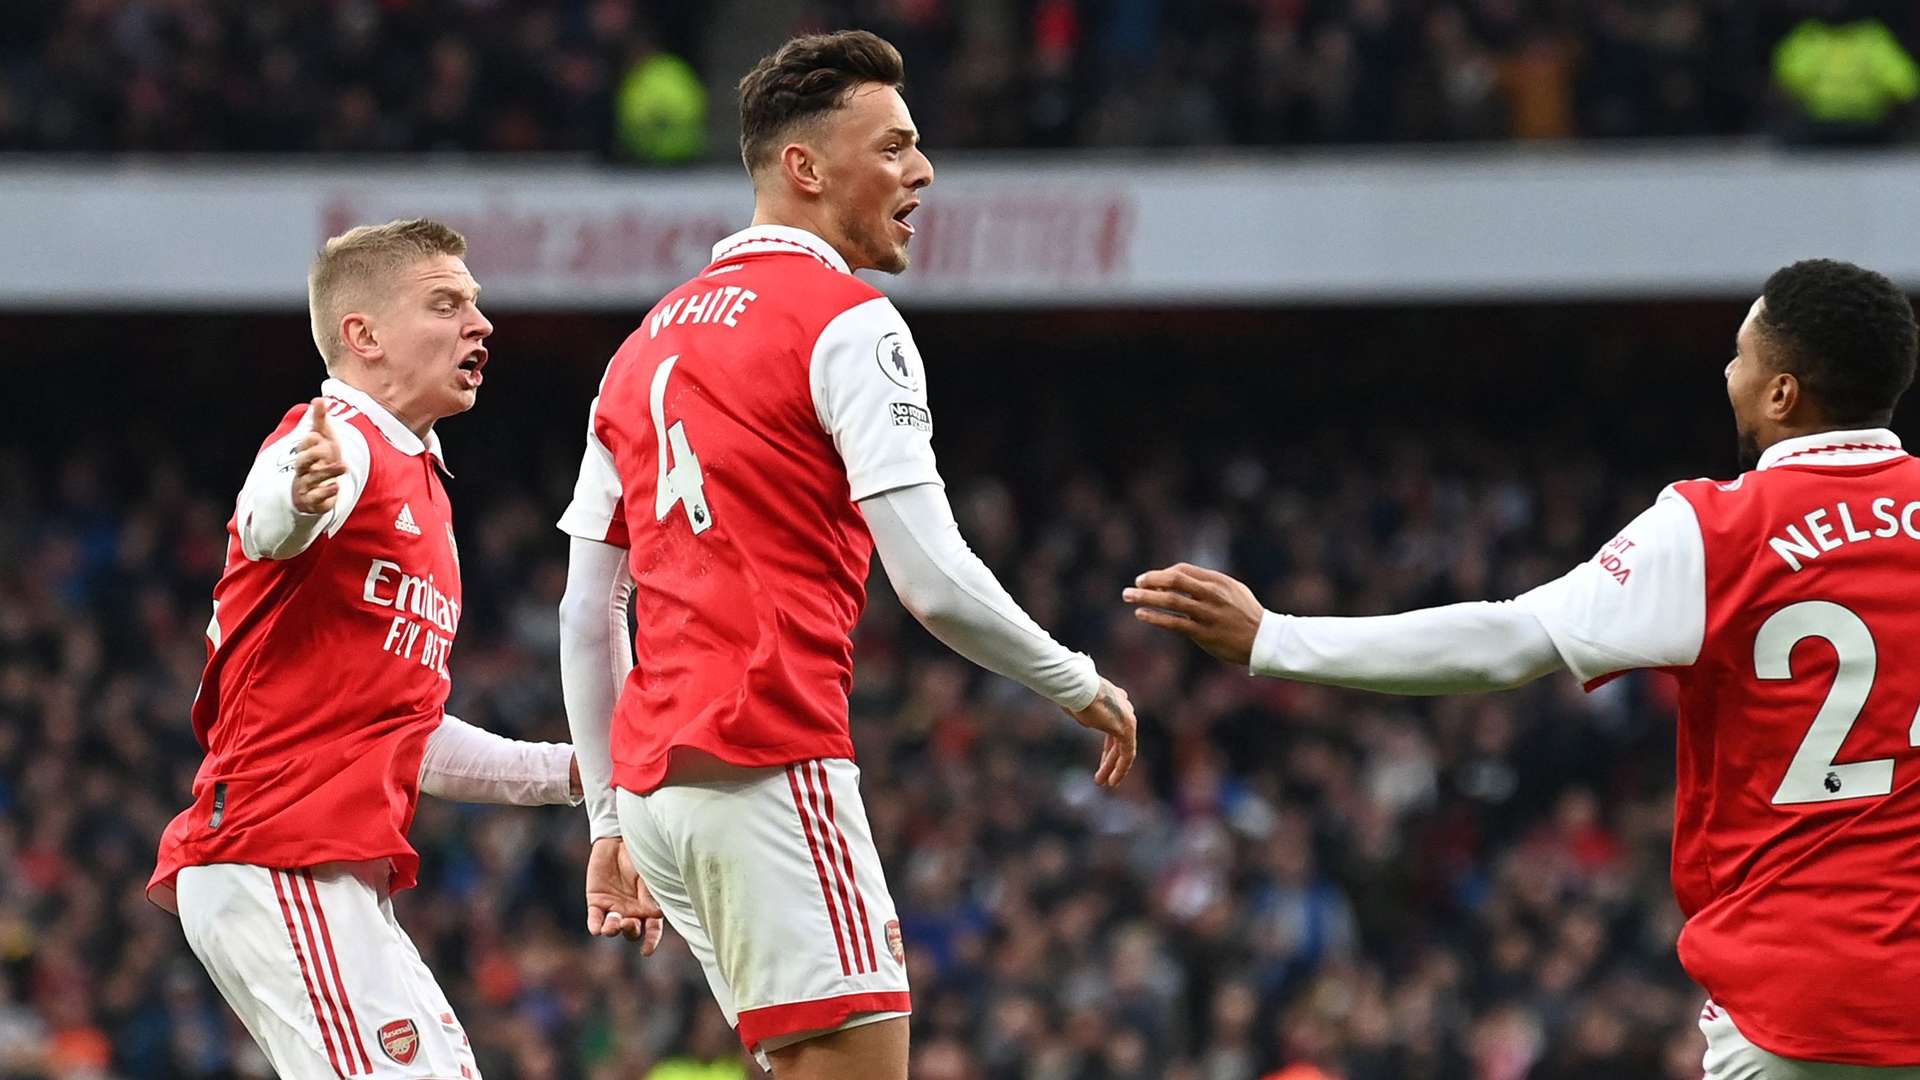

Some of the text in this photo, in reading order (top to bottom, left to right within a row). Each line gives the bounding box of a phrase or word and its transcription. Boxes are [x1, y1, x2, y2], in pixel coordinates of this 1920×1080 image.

[650, 285, 758, 340] WHITE
[649, 354, 713, 536] 4
[382, 615, 453, 675] FLY BET
[1753, 599, 1920, 806] 2
